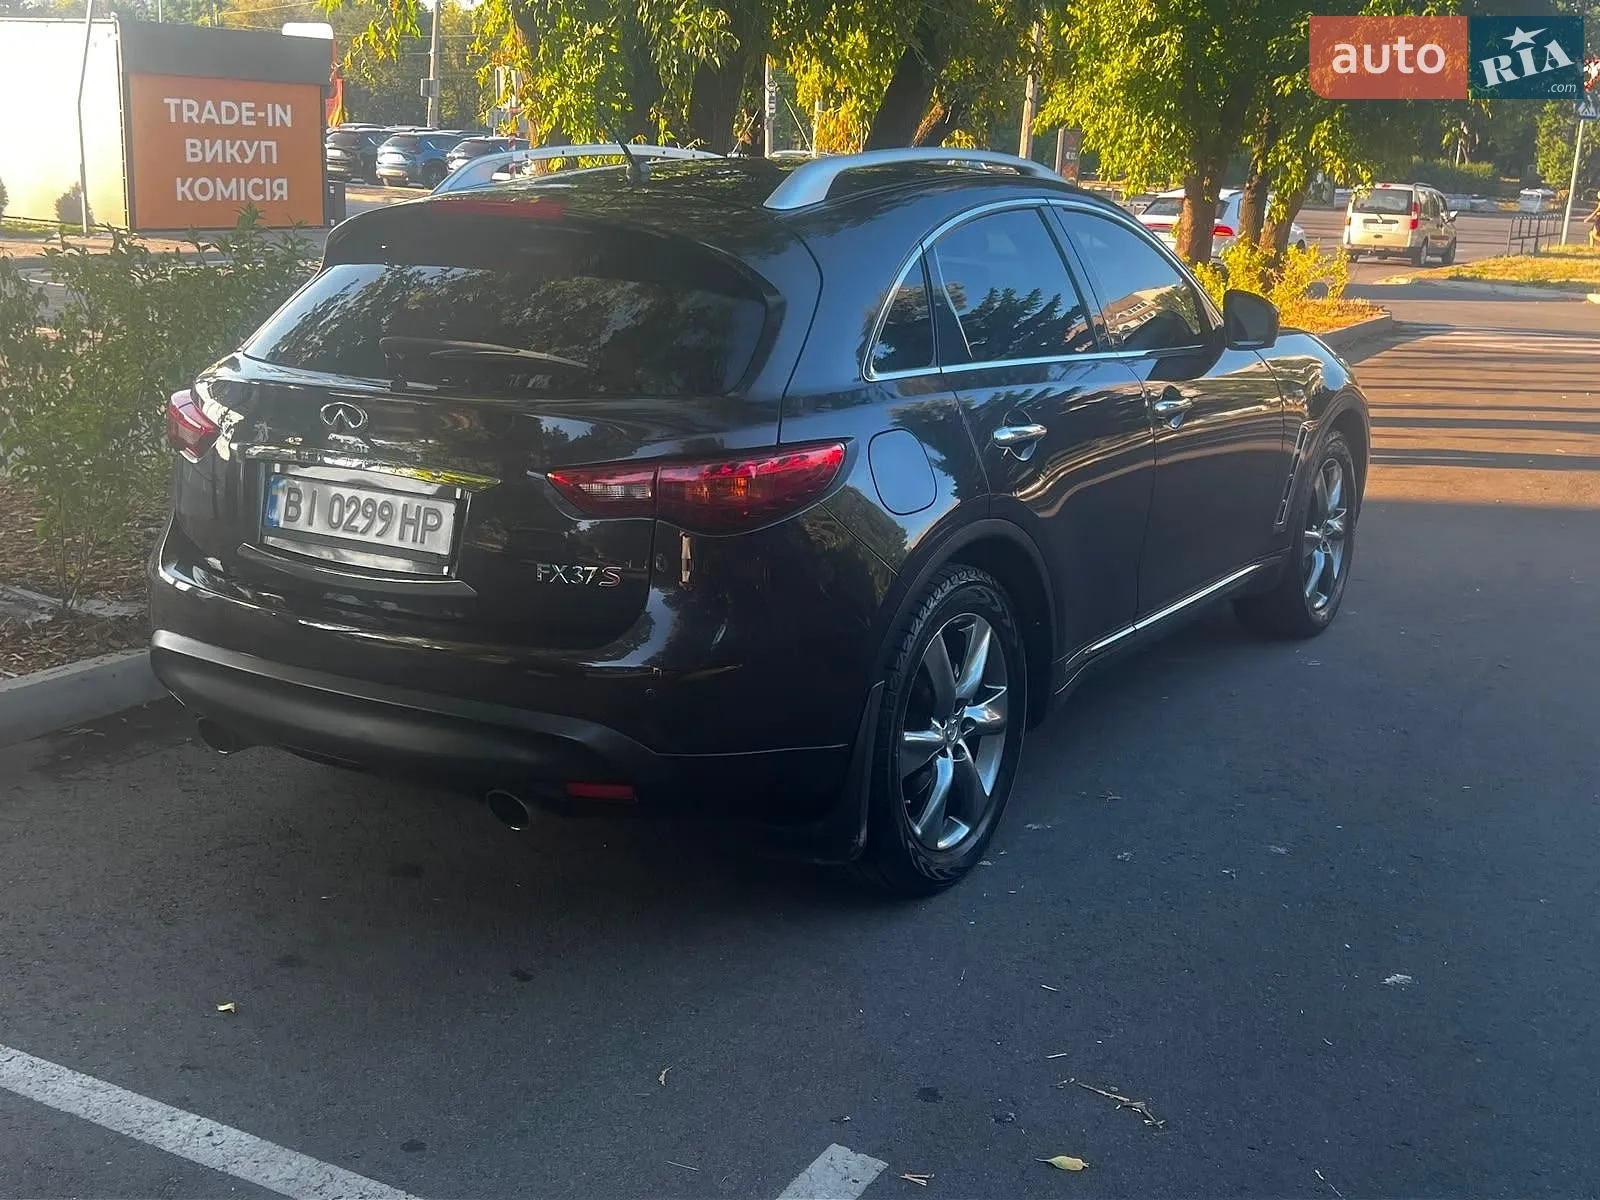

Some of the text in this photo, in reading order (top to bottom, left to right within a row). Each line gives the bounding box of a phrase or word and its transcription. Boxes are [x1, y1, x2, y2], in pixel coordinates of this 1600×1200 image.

[163, 97, 292, 128] TRADE-IN
[185, 138, 278, 164] ВИКУП
[176, 177, 288, 201] КОМІСІЯ
[327, 493, 394, 538] 0299
[398, 503, 443, 545] HP
